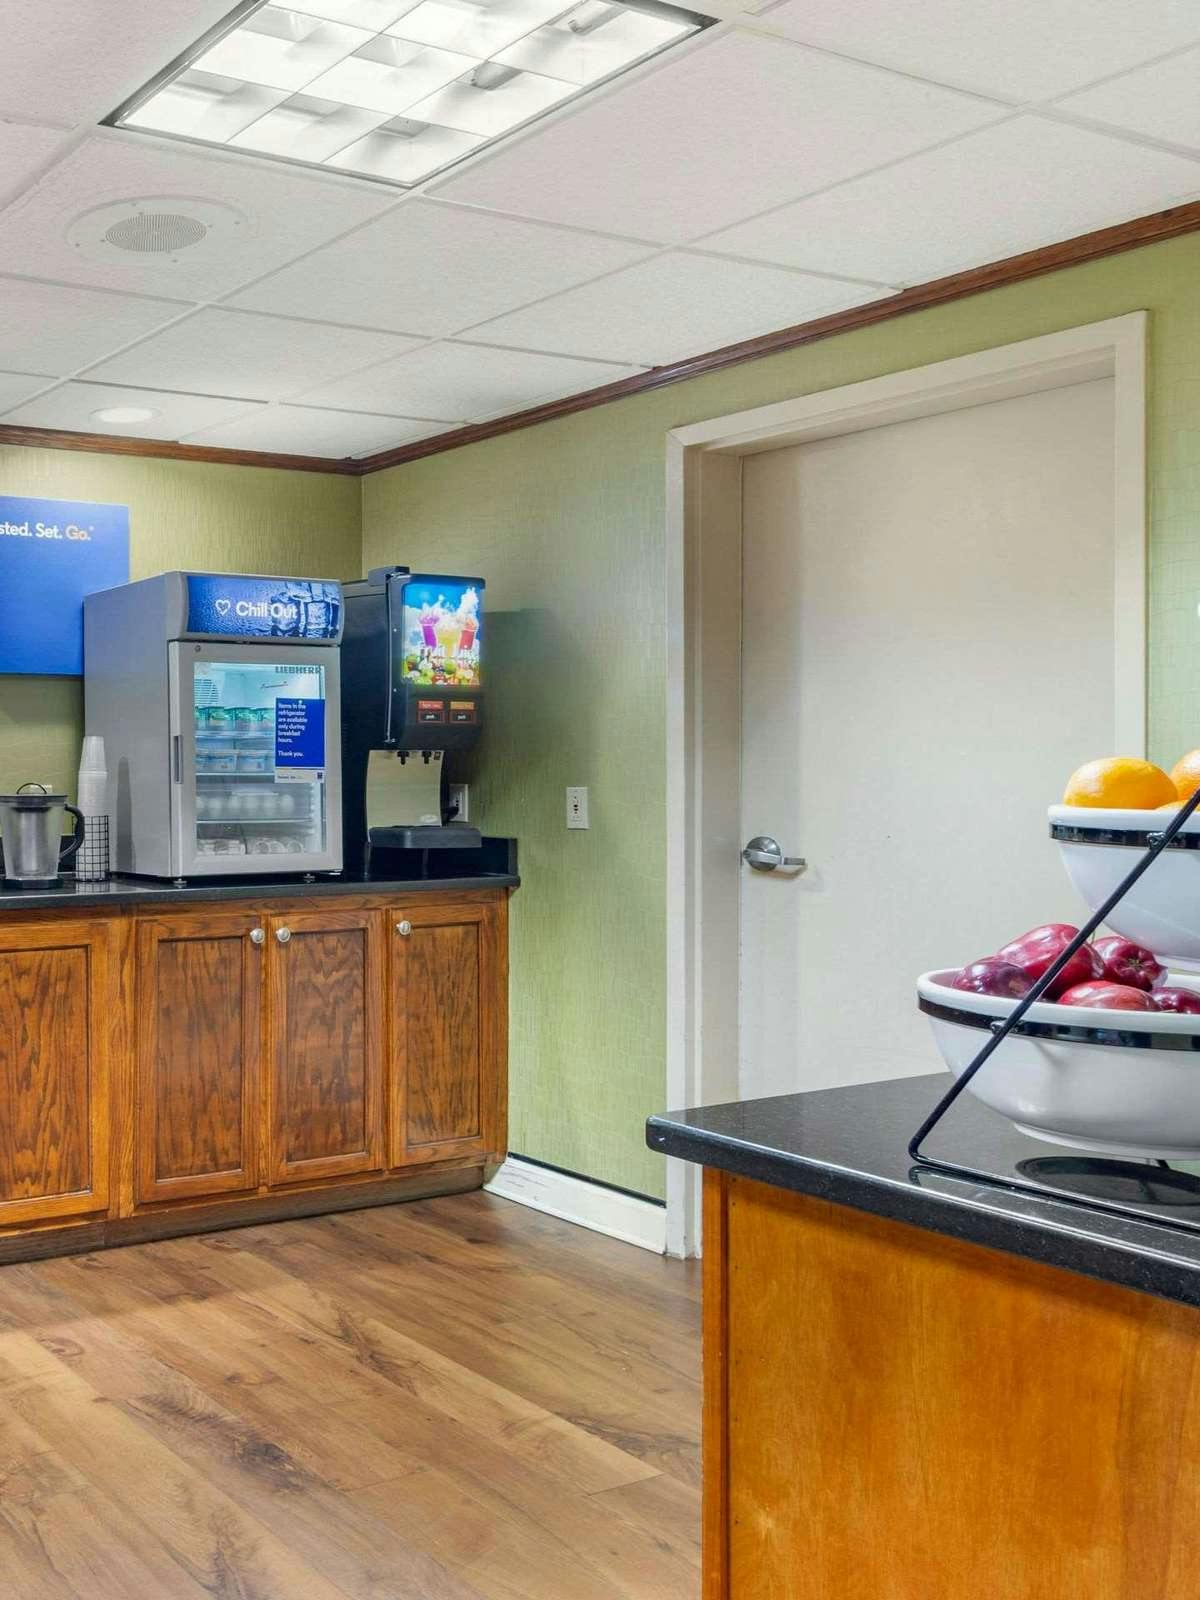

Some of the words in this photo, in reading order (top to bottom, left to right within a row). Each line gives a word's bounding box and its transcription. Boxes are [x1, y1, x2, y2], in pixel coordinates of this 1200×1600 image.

[35, 523, 63, 539] Set.
[235, 601, 268, 618] Chill
[270, 602, 298, 619] Out
[275, 666, 321, 674] LIEBHERR
